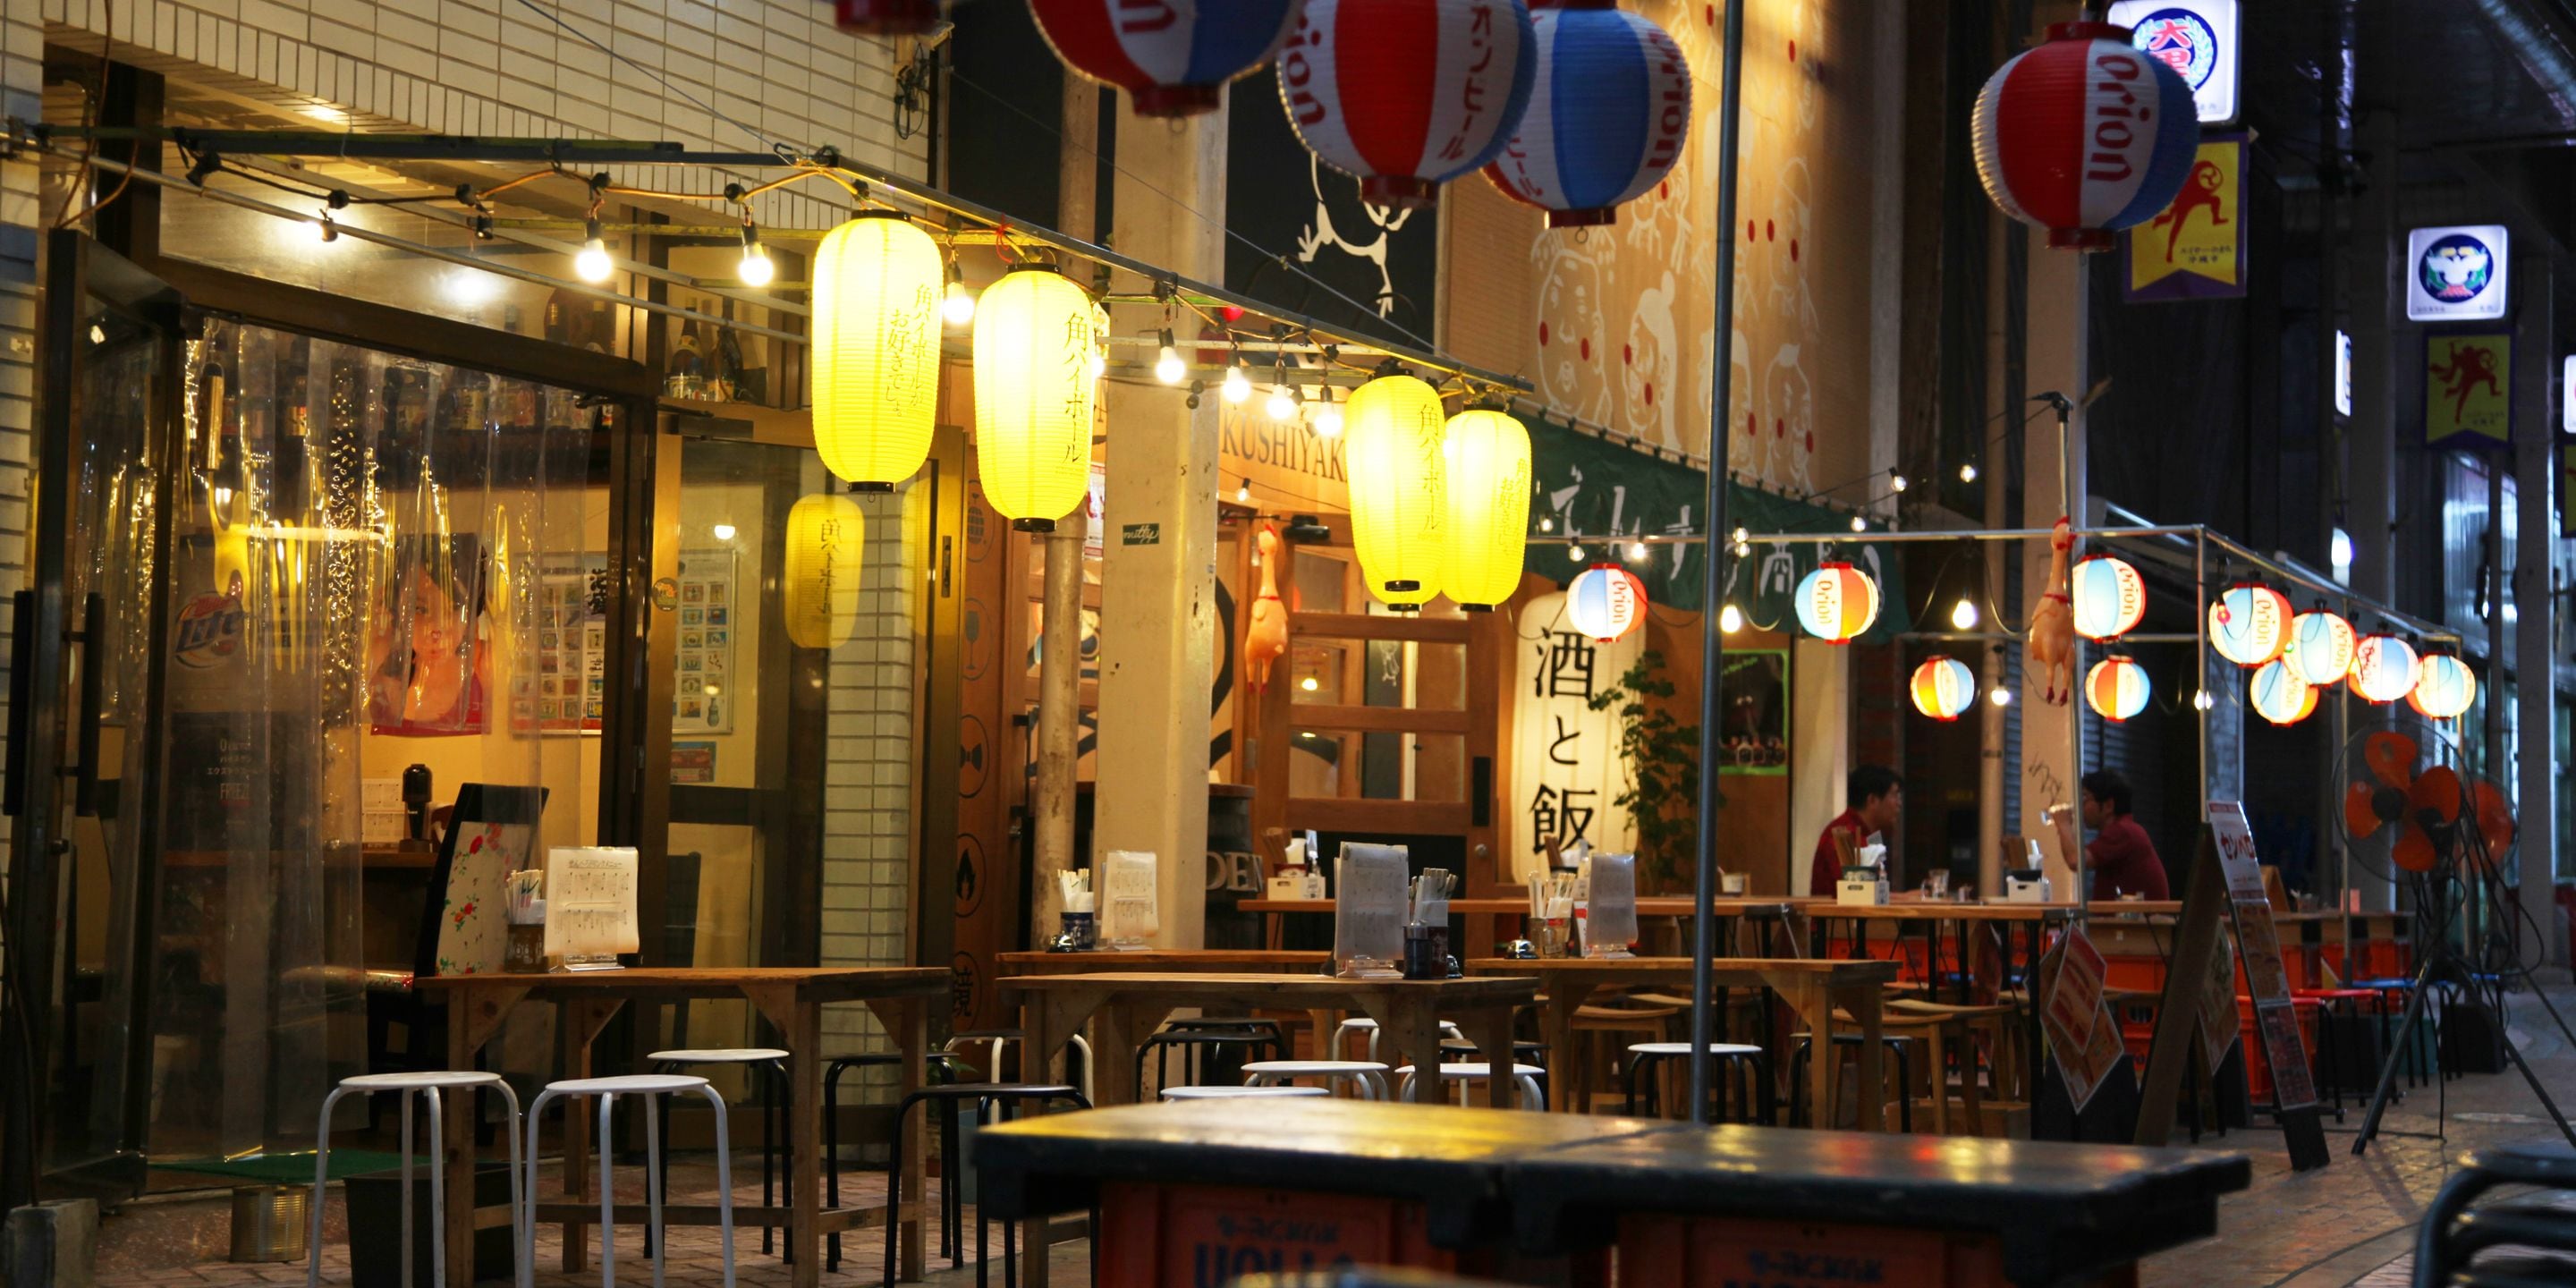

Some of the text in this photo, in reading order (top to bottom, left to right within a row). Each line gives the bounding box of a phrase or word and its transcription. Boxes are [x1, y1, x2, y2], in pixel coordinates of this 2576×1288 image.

[2087, 55, 2151, 182] Orion
[1063, 312, 1089, 464] 角ハイボール
[1221, 409, 1348, 483] KUSHIYAK
[1419, 403, 1441, 533] 角ハイボール
[1612, 580, 1631, 624] Orion
[1817, 580, 1836, 624] Orion
[2119, 566, 2140, 616] Orion
[2256, 598, 2276, 646] Orion
[2335, 623, 2351, 668] Orion
[1530, 627, 1598, 854] 酒と飯
